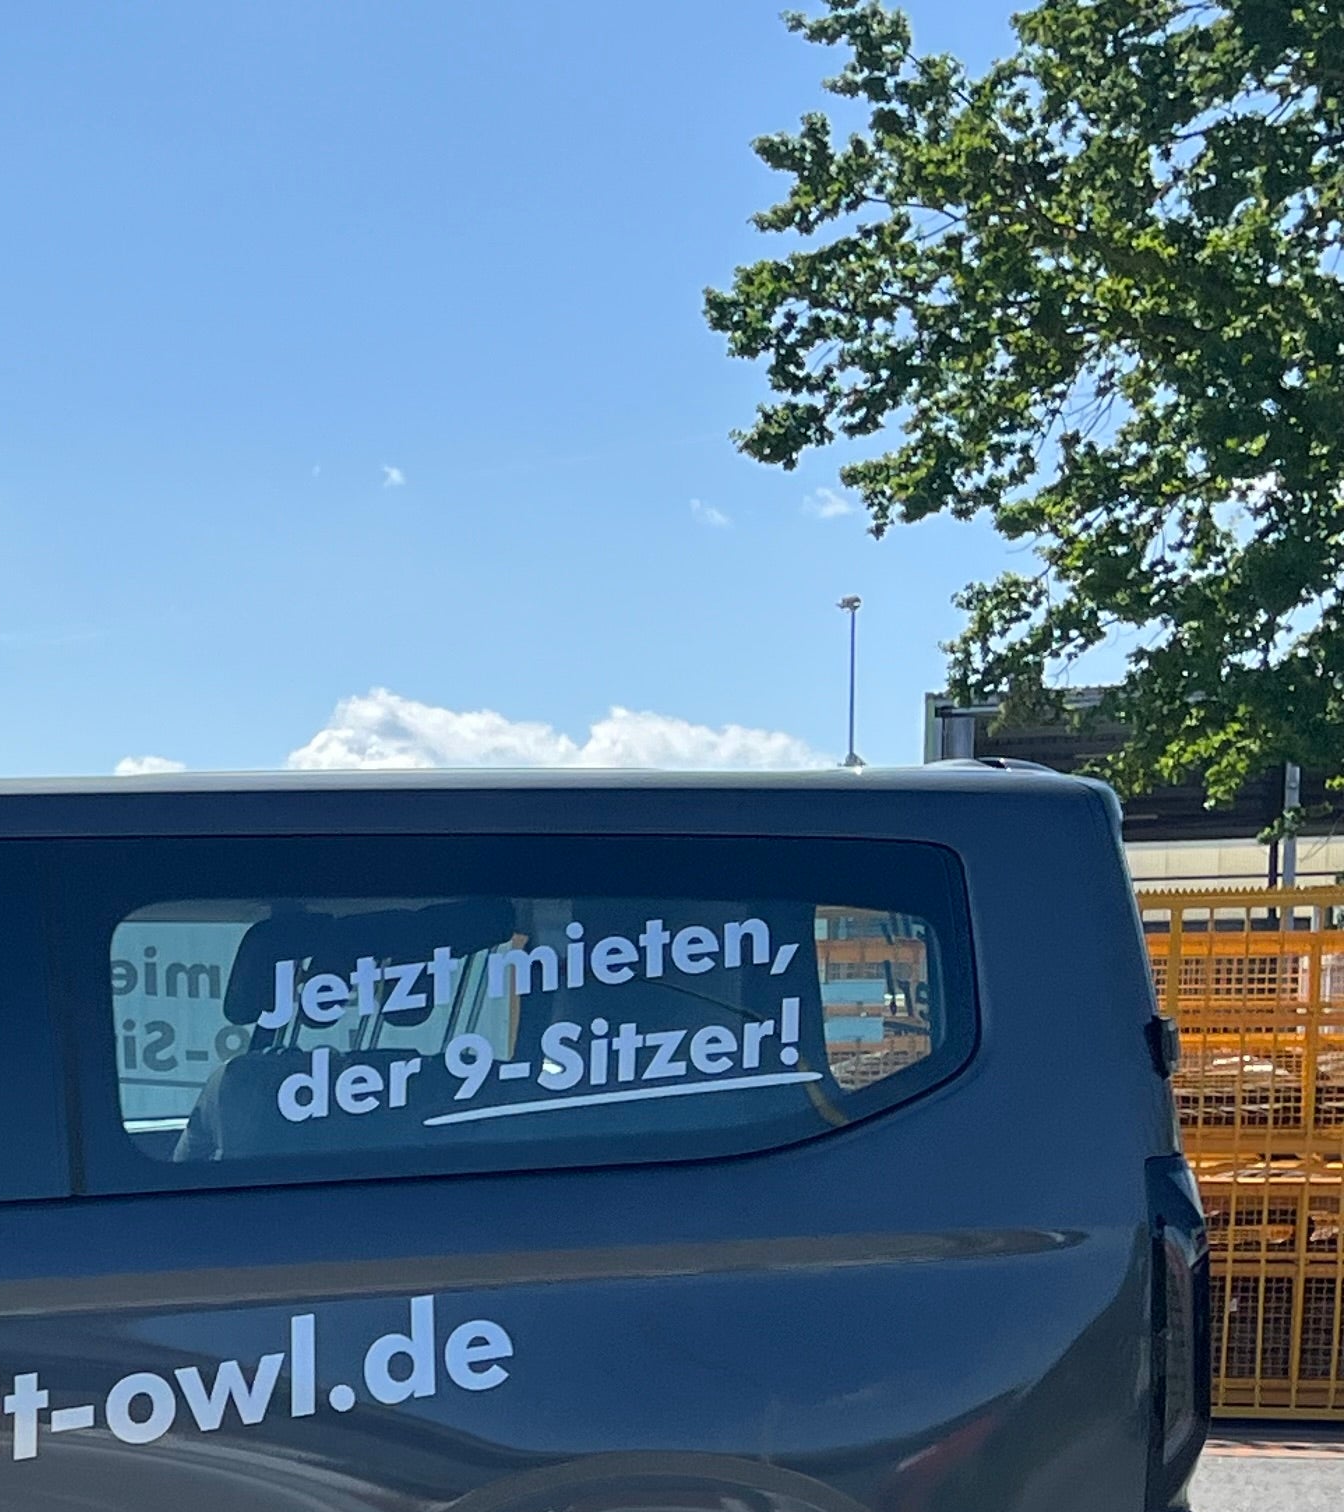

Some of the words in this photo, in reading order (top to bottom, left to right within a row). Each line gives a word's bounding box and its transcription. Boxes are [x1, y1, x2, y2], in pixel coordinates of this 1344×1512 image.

[256, 946, 459, 1030] Jetzt
[487, 917, 801, 999] mieten,
[276, 1047, 421, 1123] der
[444, 996, 802, 1102] 9-Sitzer!
